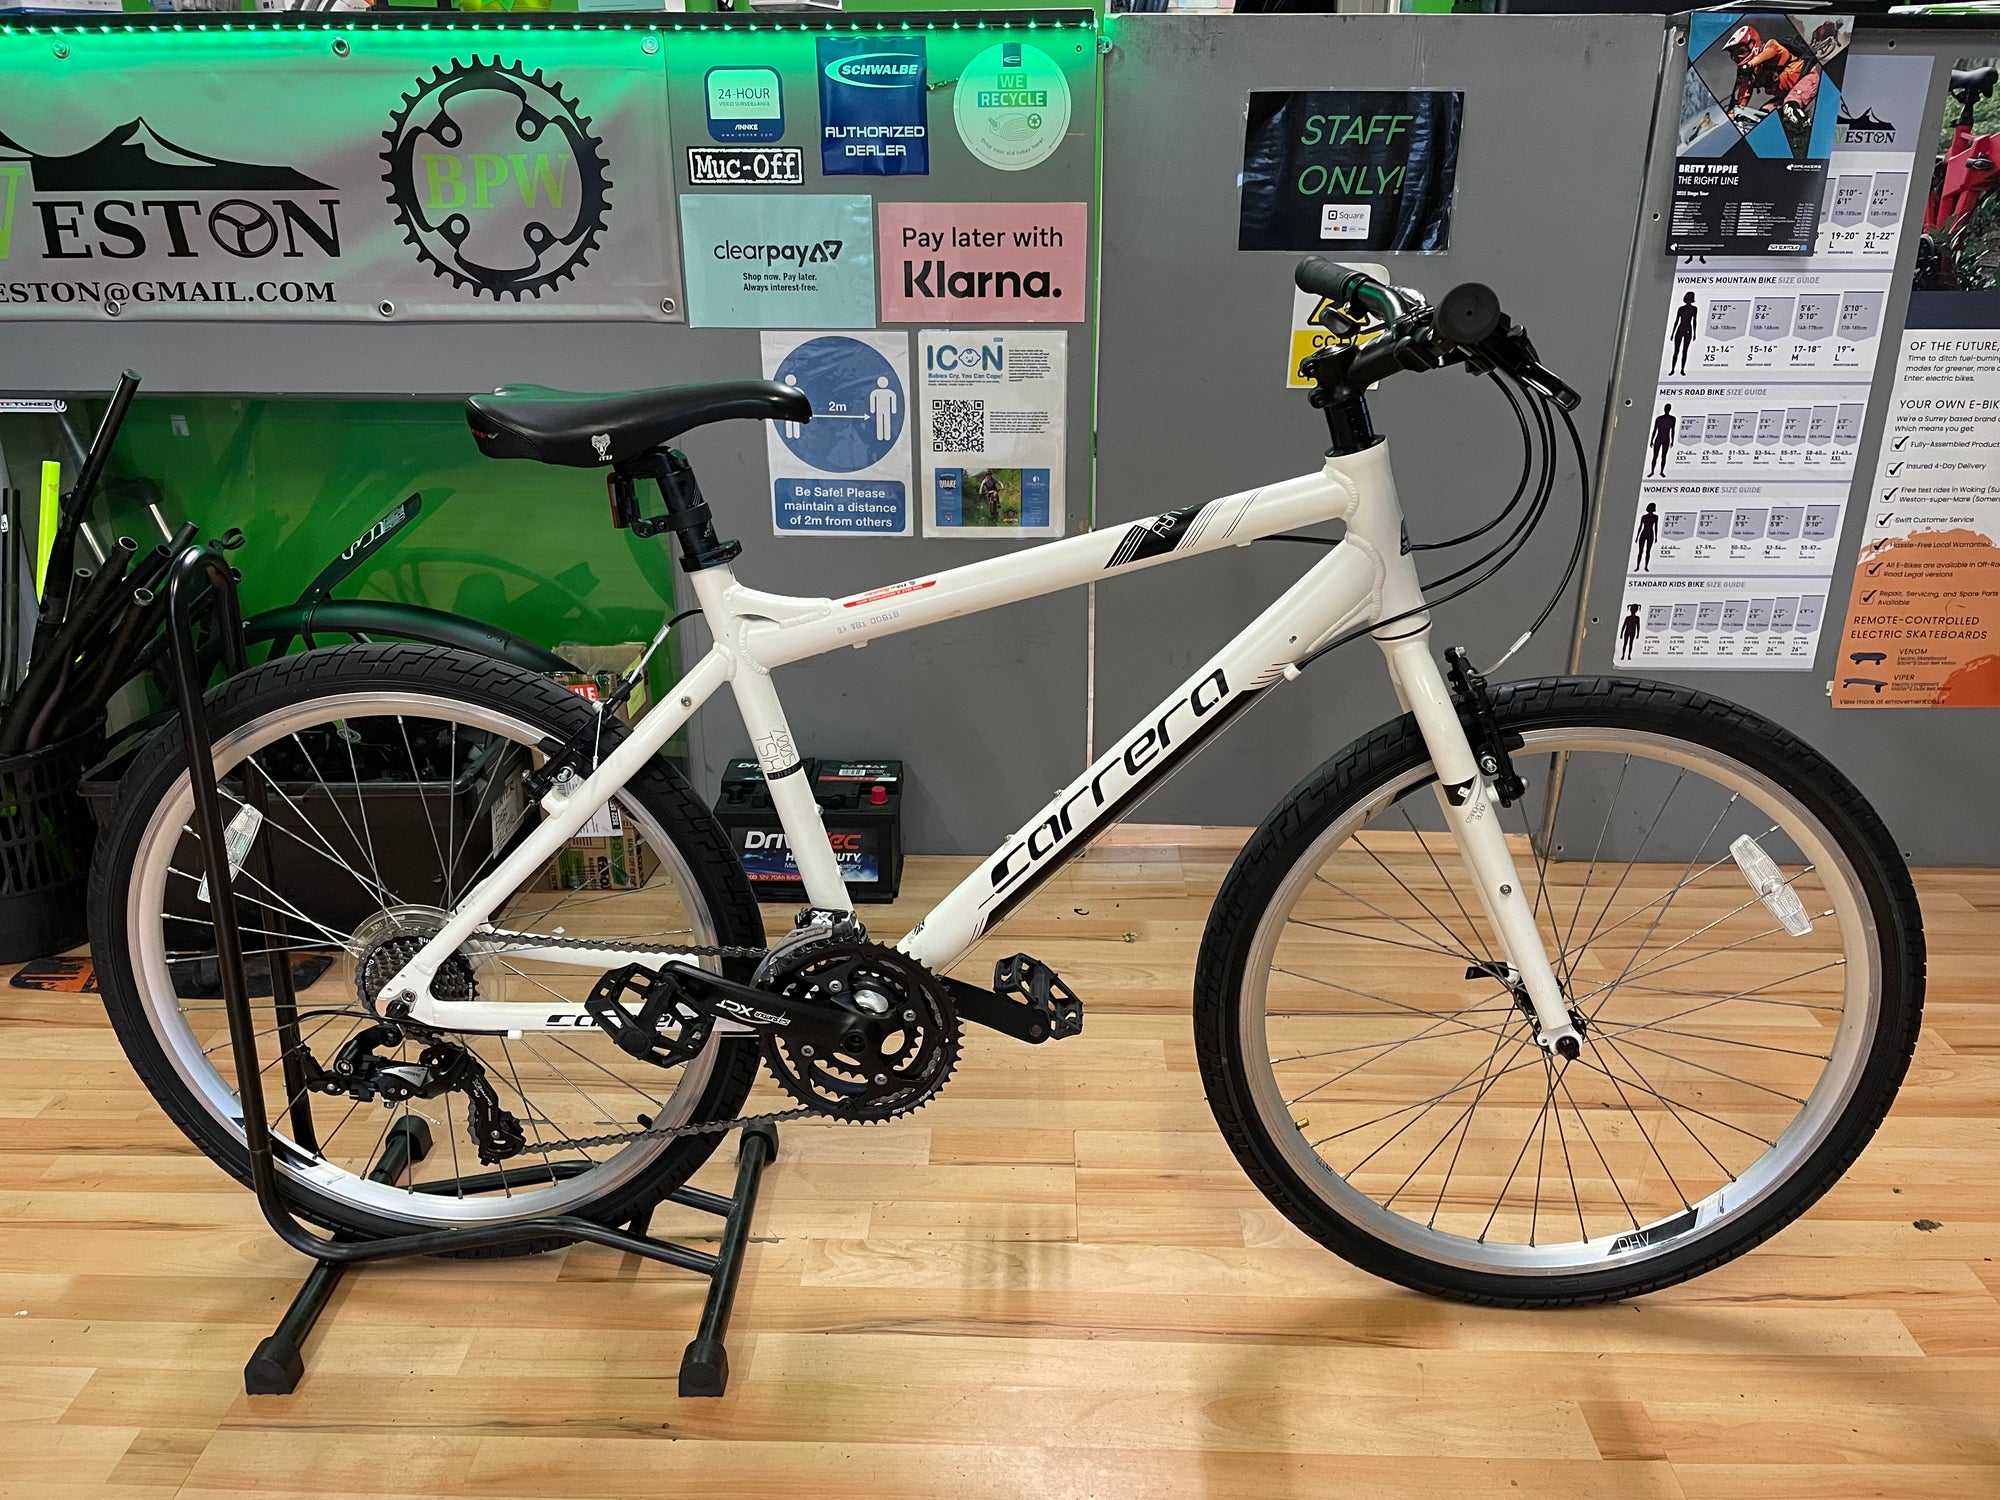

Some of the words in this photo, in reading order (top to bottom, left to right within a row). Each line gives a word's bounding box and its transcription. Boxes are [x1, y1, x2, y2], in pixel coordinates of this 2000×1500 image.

[841, 64, 919, 76] SCHWALBE
[1000, 75, 1024, 88] WE
[718, 88, 770, 100] 24-HOUR
[981, 92, 1045, 106] RECYCLE
[825, 125, 925, 139] AUTHORIZED
[1300, 115, 1413, 146] STAFF
[845, 144, 907, 157] DEALER
[694, 153, 799, 181] Muc-Off
[1678, 164, 1705, 174] BRETT
[1707, 164, 1739, 174] TIPPIE
[420, 153, 572, 209] BPW
[1298, 165, 1406, 196] ONLY!
[1678, 176, 1693, 185] THE
[1694, 176, 1720, 185] RIGHT
[1720, 176, 1740, 186] LINE
[1339, 211, 1365, 221] Square
[902, 227, 945, 252] Pay
[952, 227, 1006, 248] later
[1012, 227, 1064, 248] with
[1831, 232, 1860, 240] 19-20"
[1866, 232, 1896, 240] 21-22"
[1829, 241, 1834, 249] L
[1864, 241, 1875, 250] XL
[713, 240, 810, 268] clearpay
[743, 273, 762, 282] Shop
[763, 274, 781, 282] now.
[783, 273, 797, 282] Pay
[798, 273, 818, 282] later.
[903, 260, 1063, 299] Klarna.
[1677, 276, 1714, 284] WOMEN'S
[1715, 276, 1757, 284] MOUNTAIN
[1758, 276, 1776, 284] BIKE
[1778, 276, 1796, 284] SIZE
[1796, 276, 1820, 284] GUIDE
[743, 284, 769, 293] Always
[770, 284, 818, 292] interest-free.
[1910, 341, 1927, 351] OF
[1931, 341, 1952, 351] THE
[1956, 341, 2000, 352] FUTURE,
[927, 344, 1003, 372] ICON
[1908, 354, 1926, 362] Time
[1938, 354, 1958, 362] ditch
[1945, 366, 1974, 374] greener,
[1659, 388, 1684, 396] MEN'S
[1684, 388, 1706, 396] ROAD
[1707, 388, 1725, 396] BIKE
[1726, 388, 1743, 396] SIZE
[1744, 388, 1768, 396] GUIDE
[828, 402, 847, 412] 2m
[1900, 400, 1932, 409] YOUR
[1935, 400, 1966, 409] OWN
[1969, 400, 2000, 409] E-BIK
[1958, 463, 1986, 471] Delivery
[795, 486, 812, 497] Be
[814, 486, 843, 498] Safe!
[847, 488, 886, 498] Please
[1644, 486, 1679, 494] WOMEN'S
[1680, 486, 1701, 494] ROAD
[1702, 486, 1720, 494] BIKE
[1720, 486, 1738, 494] SIZE
[1738, 486, 1761, 494] GUIDE
[1960, 486, 1986, 494] Woking
[784, 502, 836, 512] maintain
[838, 504, 844, 512] a
[847, 502, 897, 513] distance
[790, 516, 802, 525] of
[804, 516, 822, 526] 2m
[825, 516, 852, 526] from
[855, 517, 892, 527] others
[1628, 580, 1668, 588] STANDARD
[1668, 580, 1686, 588] KIDS
[1687, 580, 1705, 588] BIKE
[1706, 580, 1723, 588] SIZE
[1723, 580, 1746, 588] GUIDE
[1853, 616, 1980, 626] REMOTE-CONTROLLED
[1850, 630, 1902, 639] ELECTRIC
[1906, 630, 1988, 640] SKATEBOARDS
[990, 667, 1230, 895] carrera
